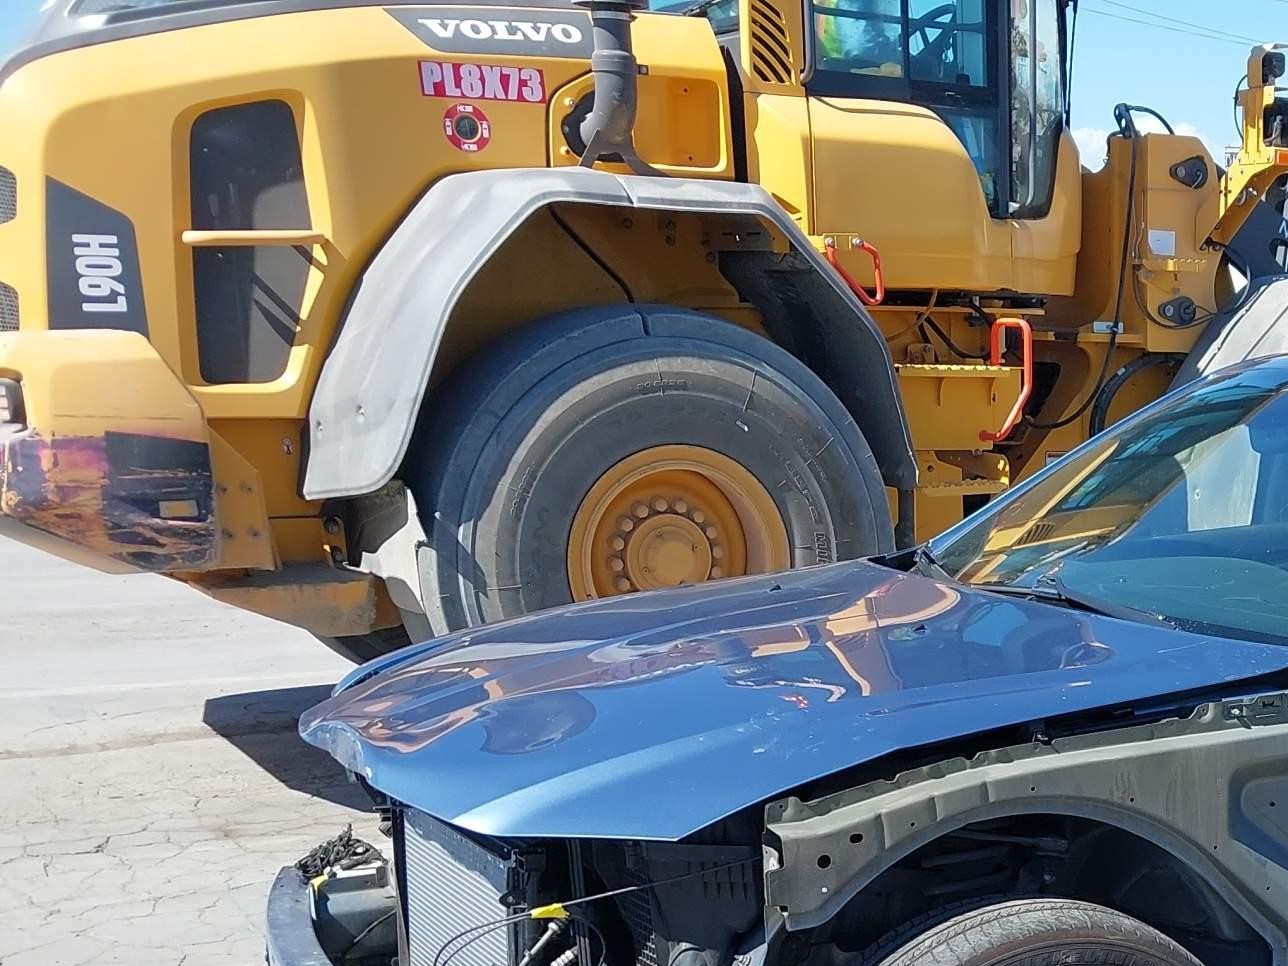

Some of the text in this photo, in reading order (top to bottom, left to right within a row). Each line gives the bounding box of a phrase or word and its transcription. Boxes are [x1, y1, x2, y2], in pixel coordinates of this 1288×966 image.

[417, 19, 583, 43] VOLVO
[420, 61, 543, 102] PL8X73
[71, 233, 128, 312] L90H
